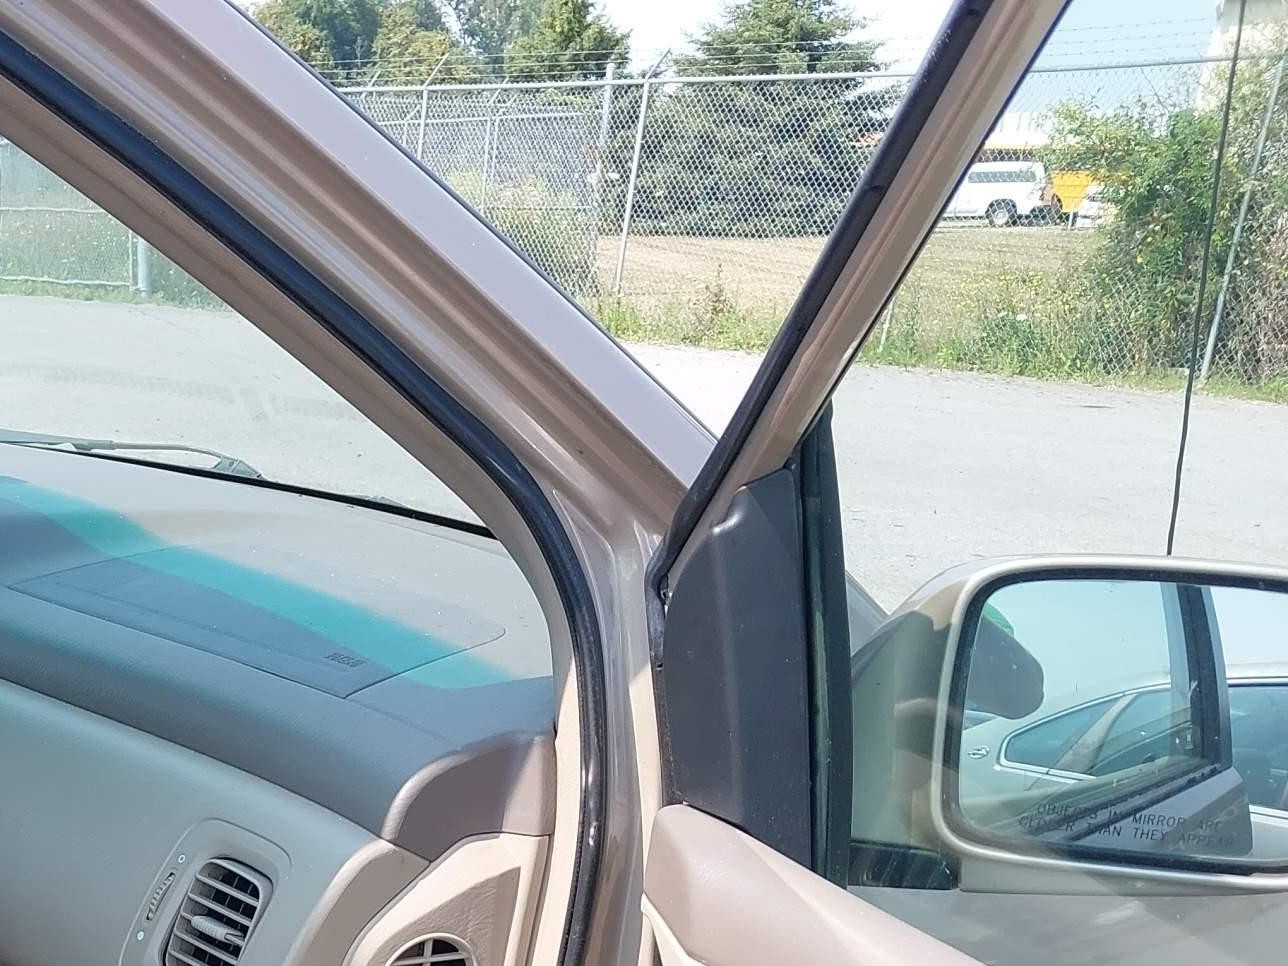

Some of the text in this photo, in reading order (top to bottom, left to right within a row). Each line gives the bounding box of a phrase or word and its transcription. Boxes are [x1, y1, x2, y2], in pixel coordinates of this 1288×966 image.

[1019, 815, 1074, 832] CLOR
[1133, 827, 1168, 841] THEY
[1177, 833, 1235, 849] APPEAR
[1132, 813, 1186, 828] MIRROR
[1198, 819, 1224, 832] ARE
